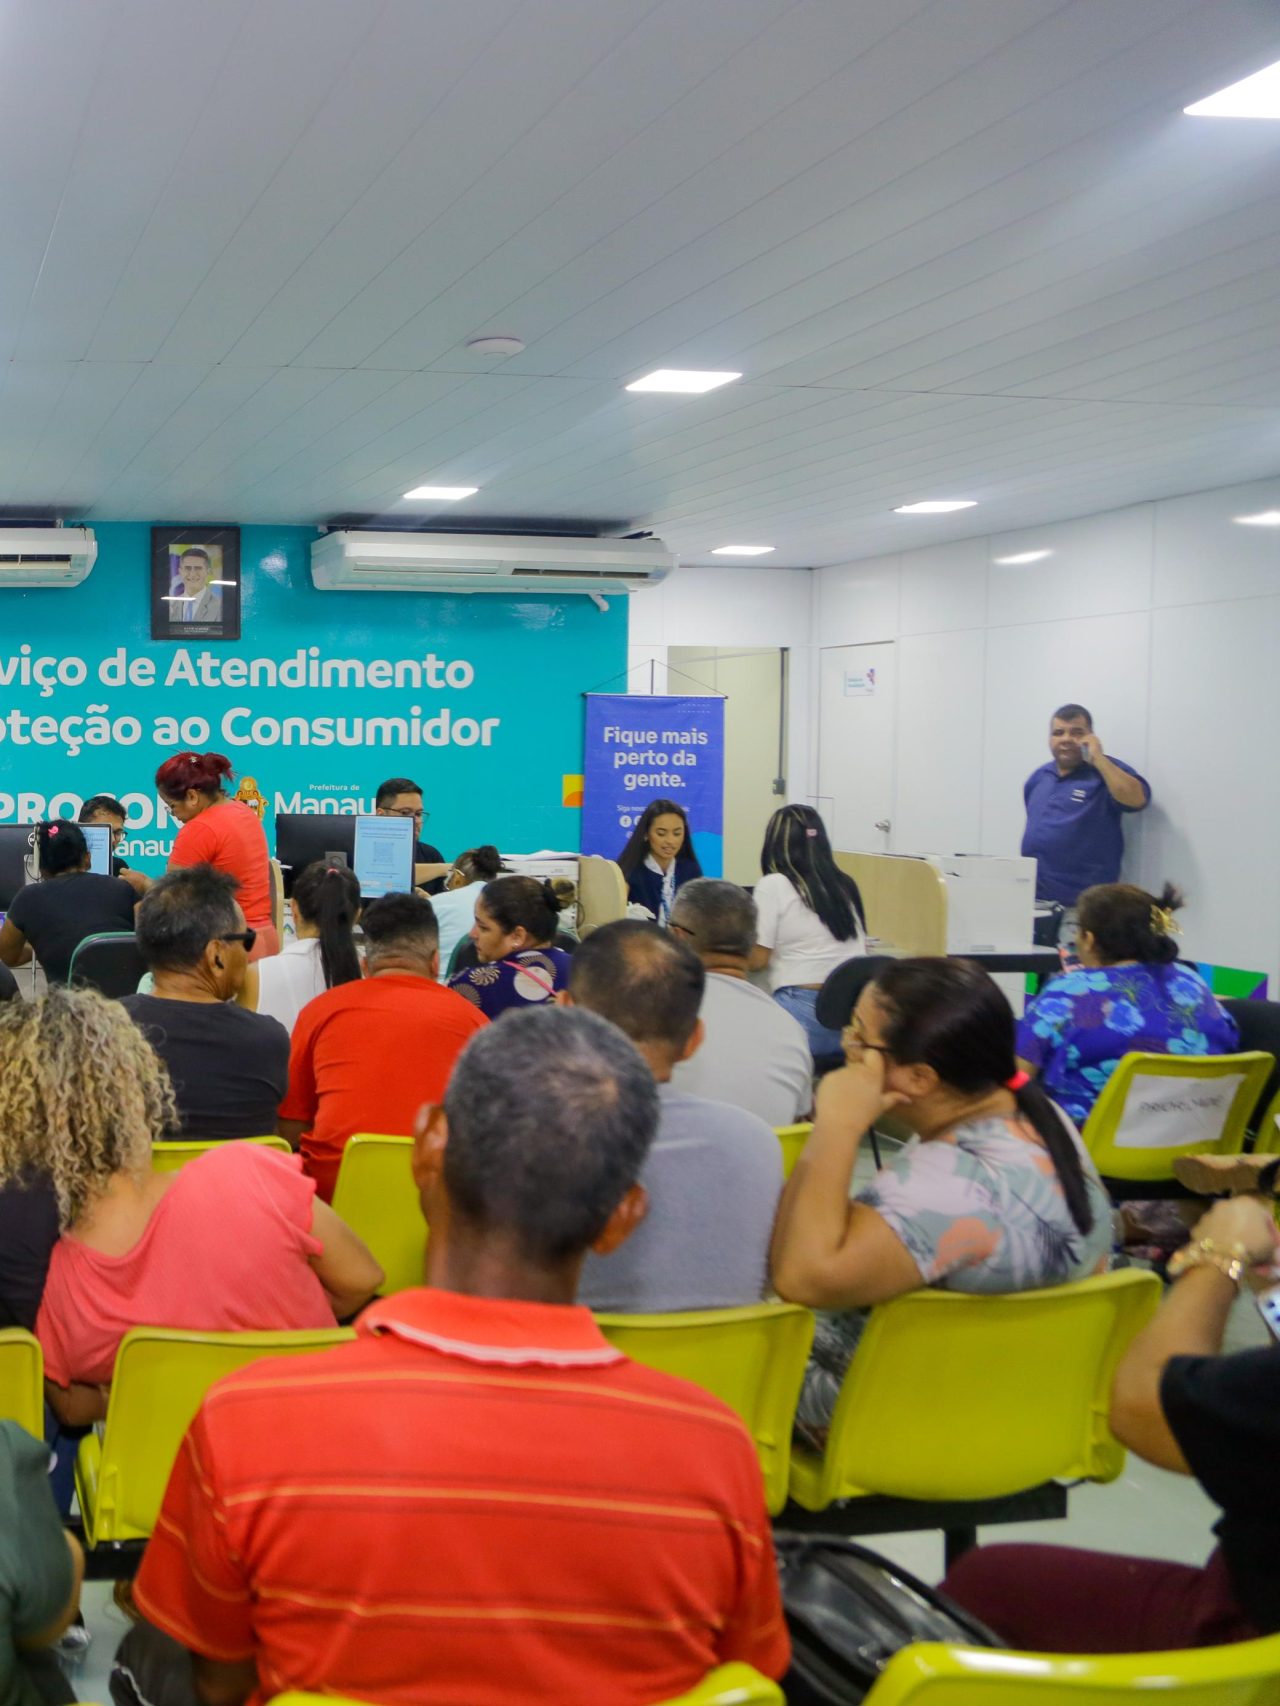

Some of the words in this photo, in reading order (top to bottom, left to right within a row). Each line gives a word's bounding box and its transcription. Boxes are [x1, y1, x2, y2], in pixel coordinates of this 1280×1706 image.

[98, 647, 156, 687] de
[164, 646, 475, 689] Atendimento
[153, 716, 210, 746] ao
[220, 705, 501, 747] Consumidor
[604, 726, 658, 747] Fique
[662, 728, 708, 745] mais
[614, 750, 669, 769] perto
[672, 750, 697, 767] da
[623, 772, 687, 791] gente.
[274, 791, 377, 815] Manau
[112, 839, 175, 857] anau
